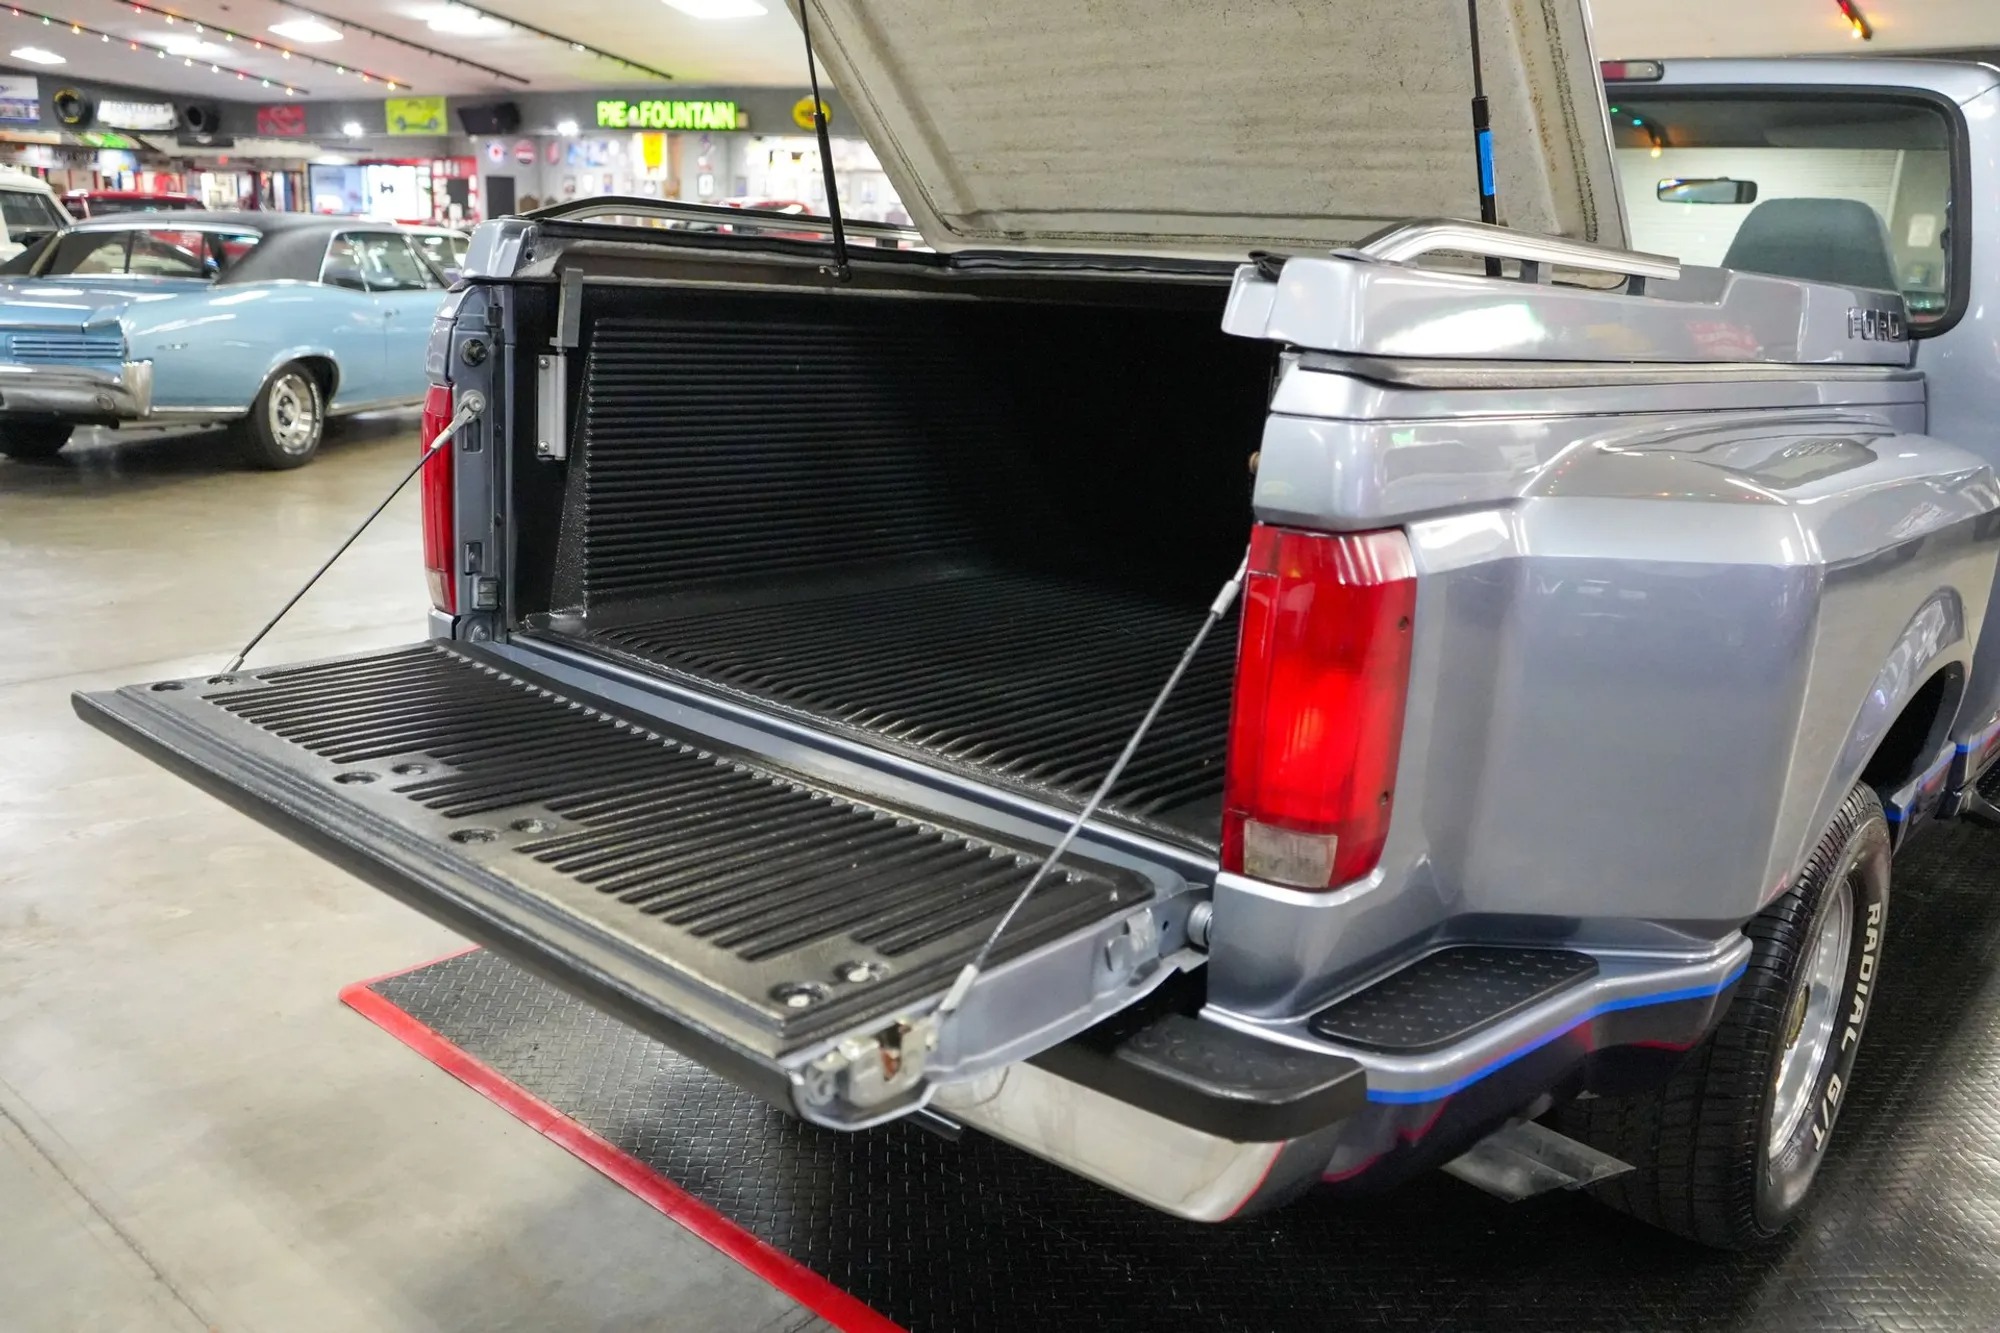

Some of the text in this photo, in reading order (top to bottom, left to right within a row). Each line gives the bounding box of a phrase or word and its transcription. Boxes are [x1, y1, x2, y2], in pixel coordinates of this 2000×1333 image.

[597, 101, 627, 127] PIE
[640, 101, 735, 129] FOUNTAIN
[1847, 308, 1901, 342] FORD
[1812, 902, 1881, 1152] RADIAL G/T
